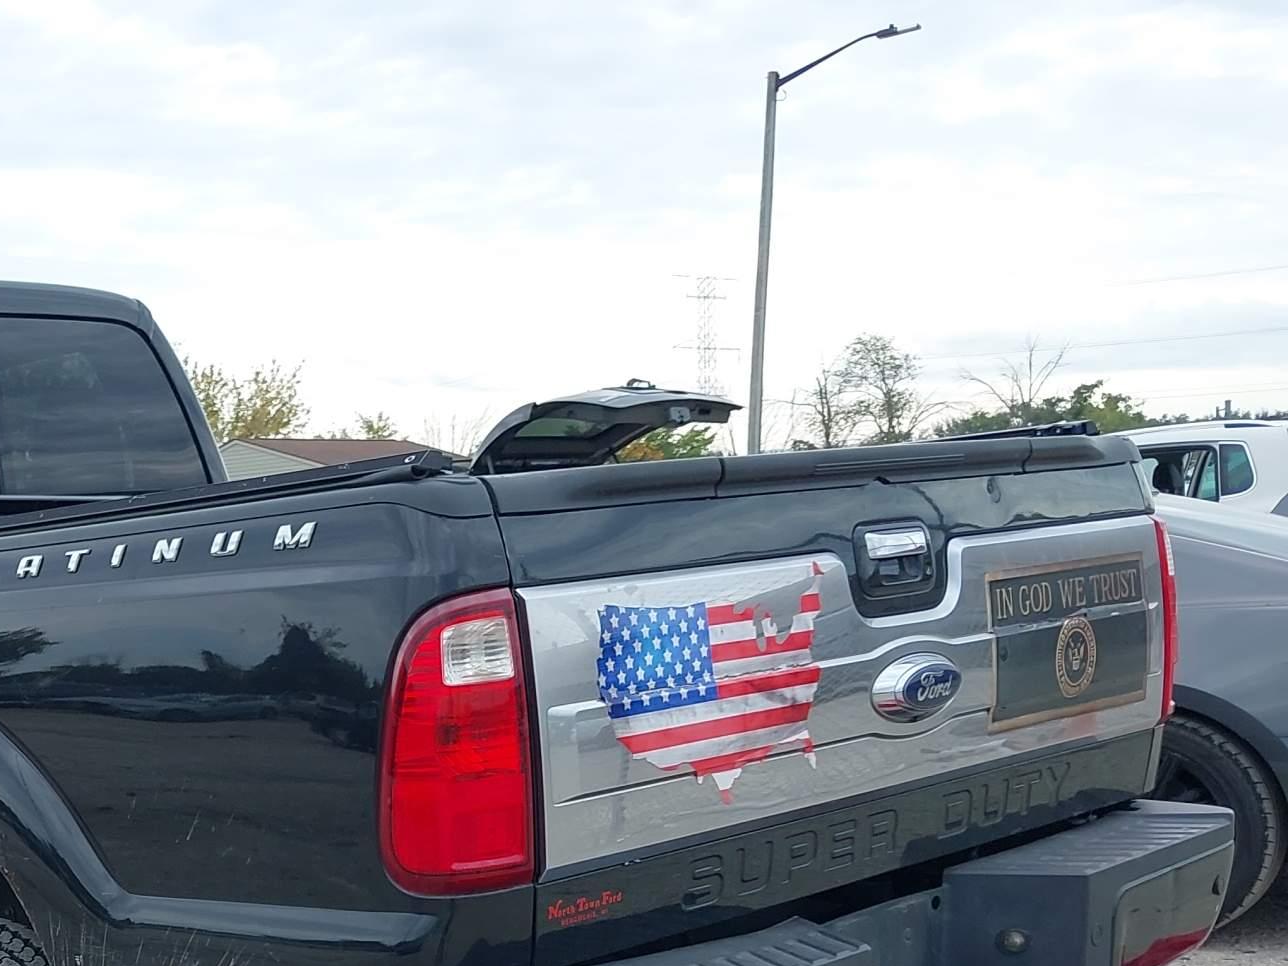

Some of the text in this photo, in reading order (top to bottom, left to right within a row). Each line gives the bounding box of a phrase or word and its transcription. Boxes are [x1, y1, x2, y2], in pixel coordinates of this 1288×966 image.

[996, 568, 1137, 620] IN GOD WE TRUST
[917, 670, 953, 702] Ford
[680, 761, 1073, 913] SUPER DUTY
[601, 890, 623, 905] Ford
